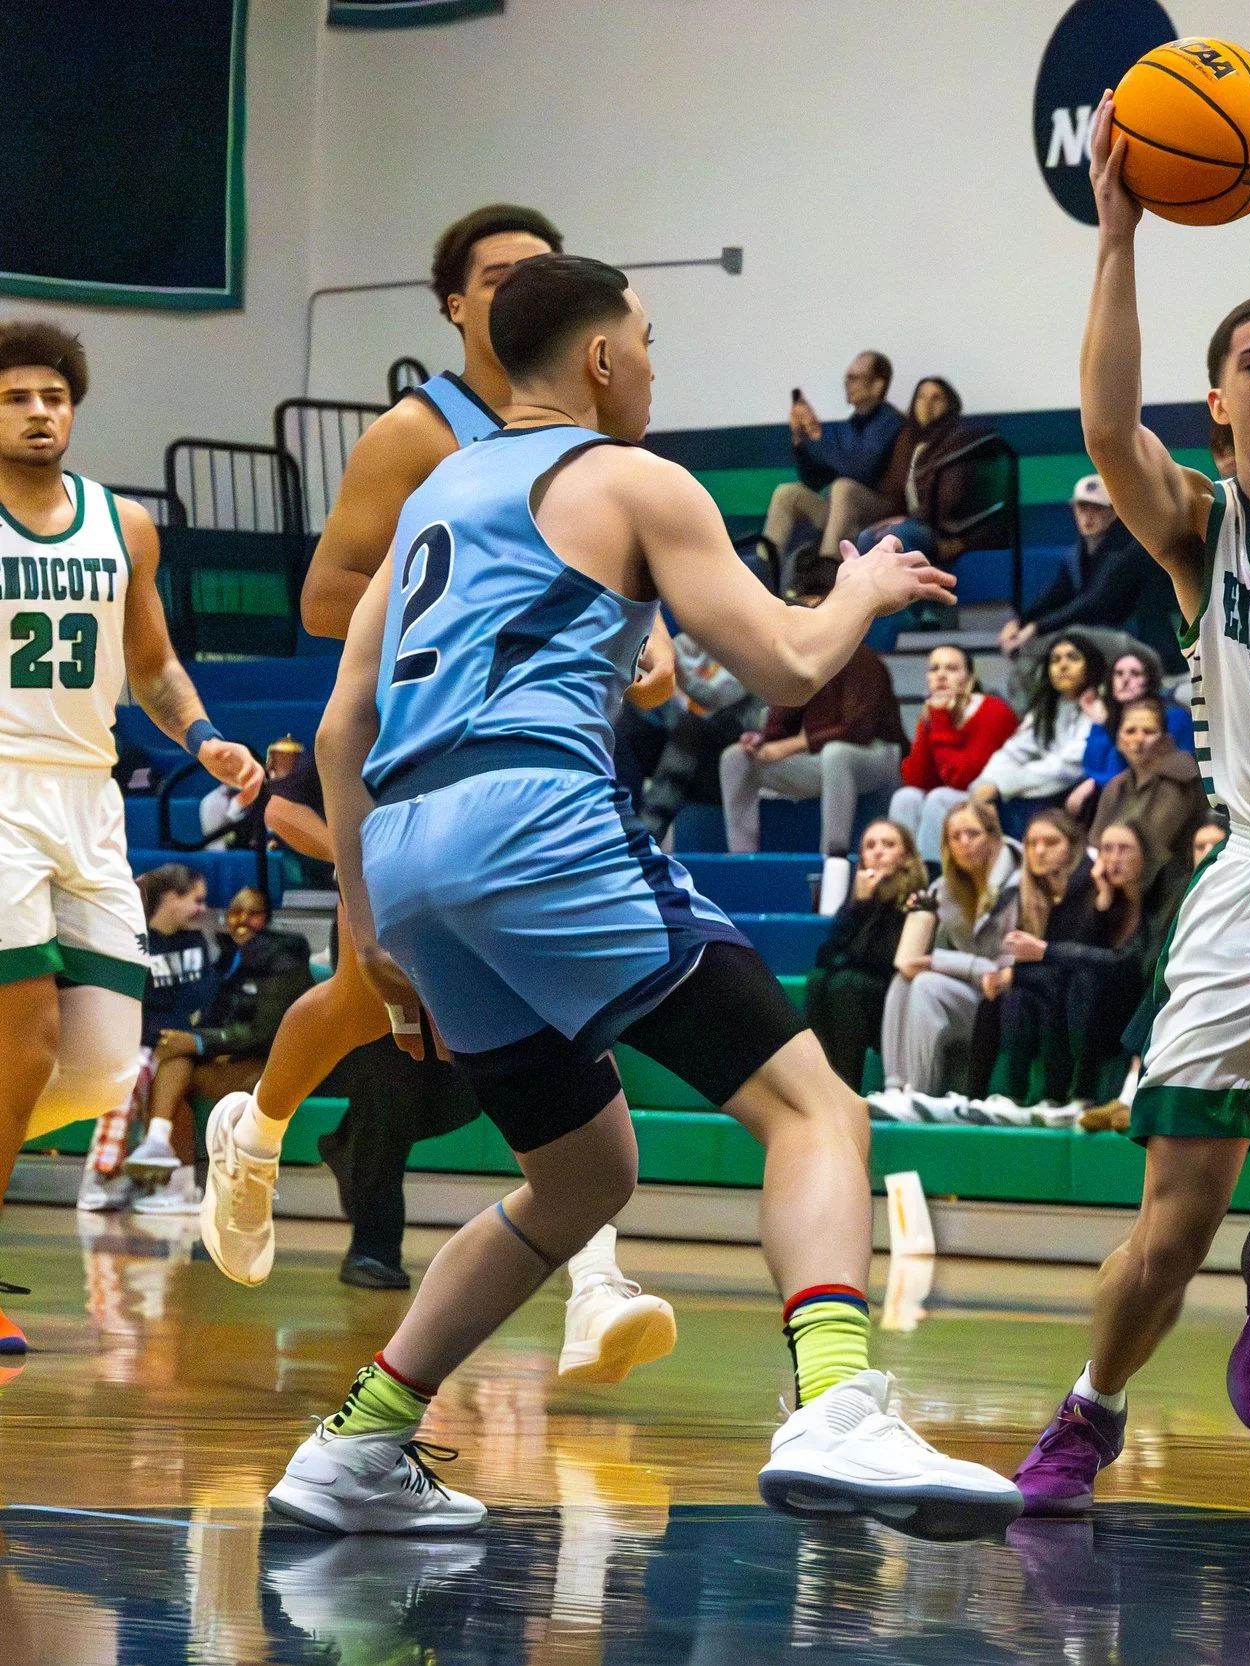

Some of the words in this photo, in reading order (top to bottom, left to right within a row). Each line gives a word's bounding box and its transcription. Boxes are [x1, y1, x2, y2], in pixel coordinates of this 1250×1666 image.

[1045, 105, 1093, 168] N
[0, 556, 117, 602] NDICOTT
[390, 519, 455, 688] 2
[10, 612, 98, 689] 23
